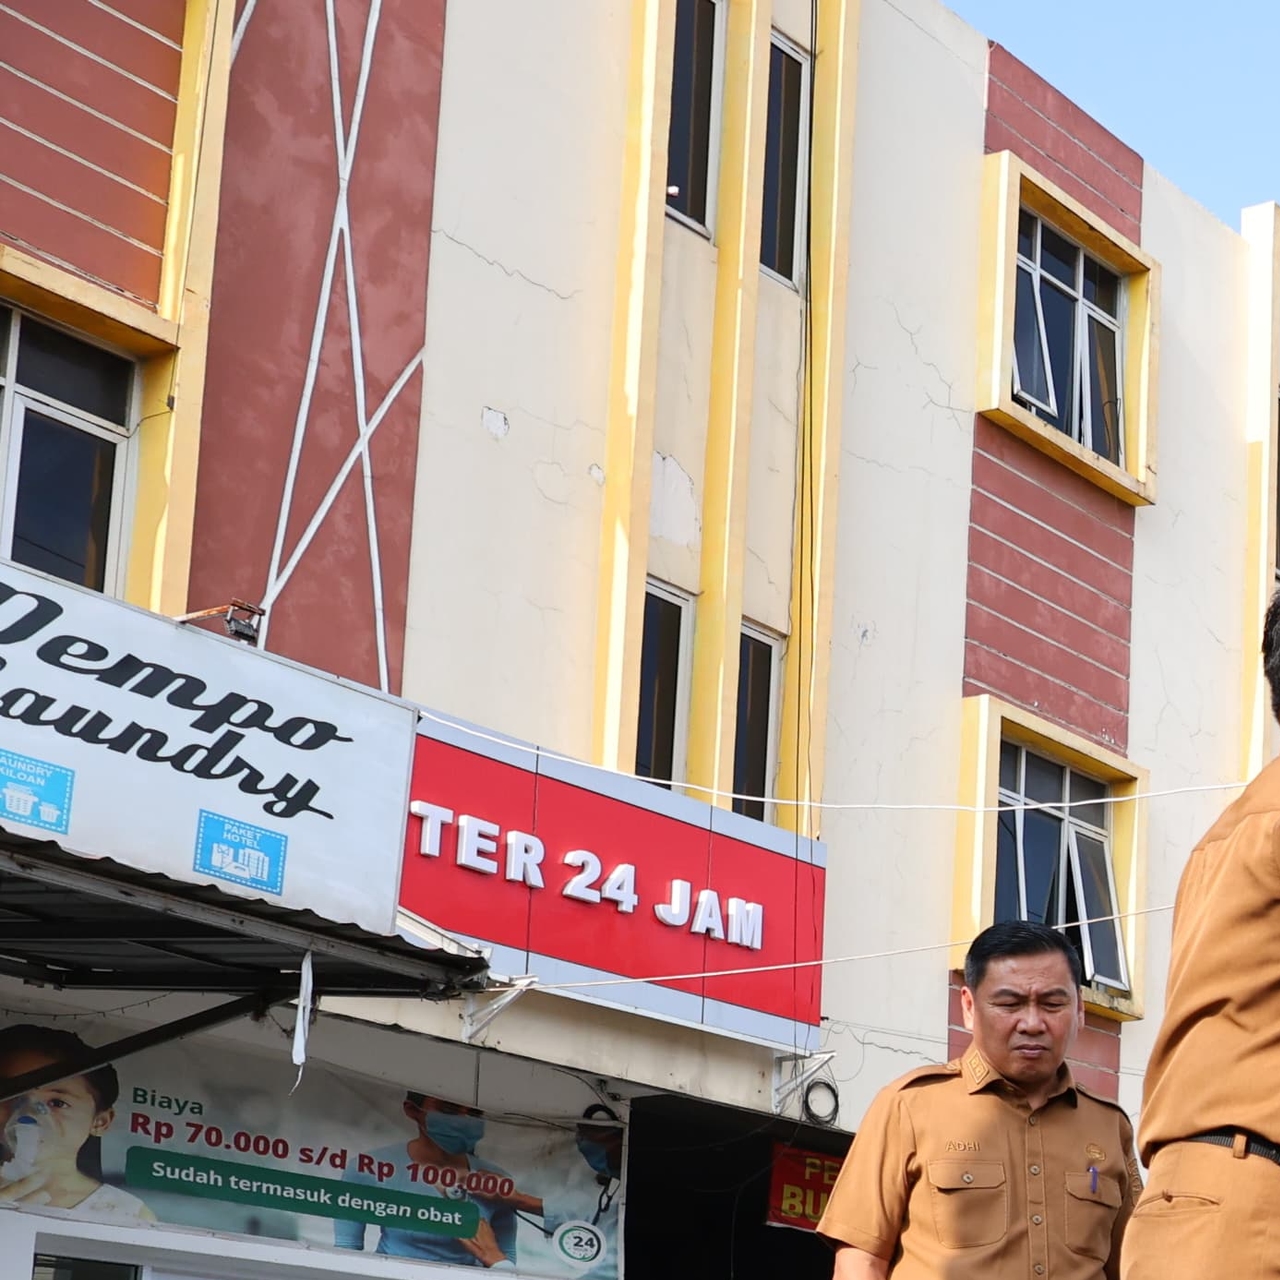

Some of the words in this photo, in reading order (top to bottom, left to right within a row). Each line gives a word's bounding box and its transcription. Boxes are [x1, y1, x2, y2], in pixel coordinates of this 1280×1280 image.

[222, 832, 260, 850] HOTEL
[224, 822, 262, 841] PAKET
[562, 849, 638, 913] 24
[654, 879, 763, 950] JAM
[132, 1087, 204, 1116] Biaya
[130, 1112, 174, 1144] Rp
[185, 1122, 289, 1159] 70.000
[299, 1146, 348, 1170] s/d
[358, 1153, 395, 1182] Rp
[406, 1163, 515, 1197] 100.000
[945, 1140, 981, 1152] ADHI
[152, 1161, 222, 1187] Sudah
[229, 1175, 332, 1205] termasuk
[337, 1191, 412, 1218] dengan
[417, 1201, 463, 1226] obat
[572, 1235, 596, 1249] 24
